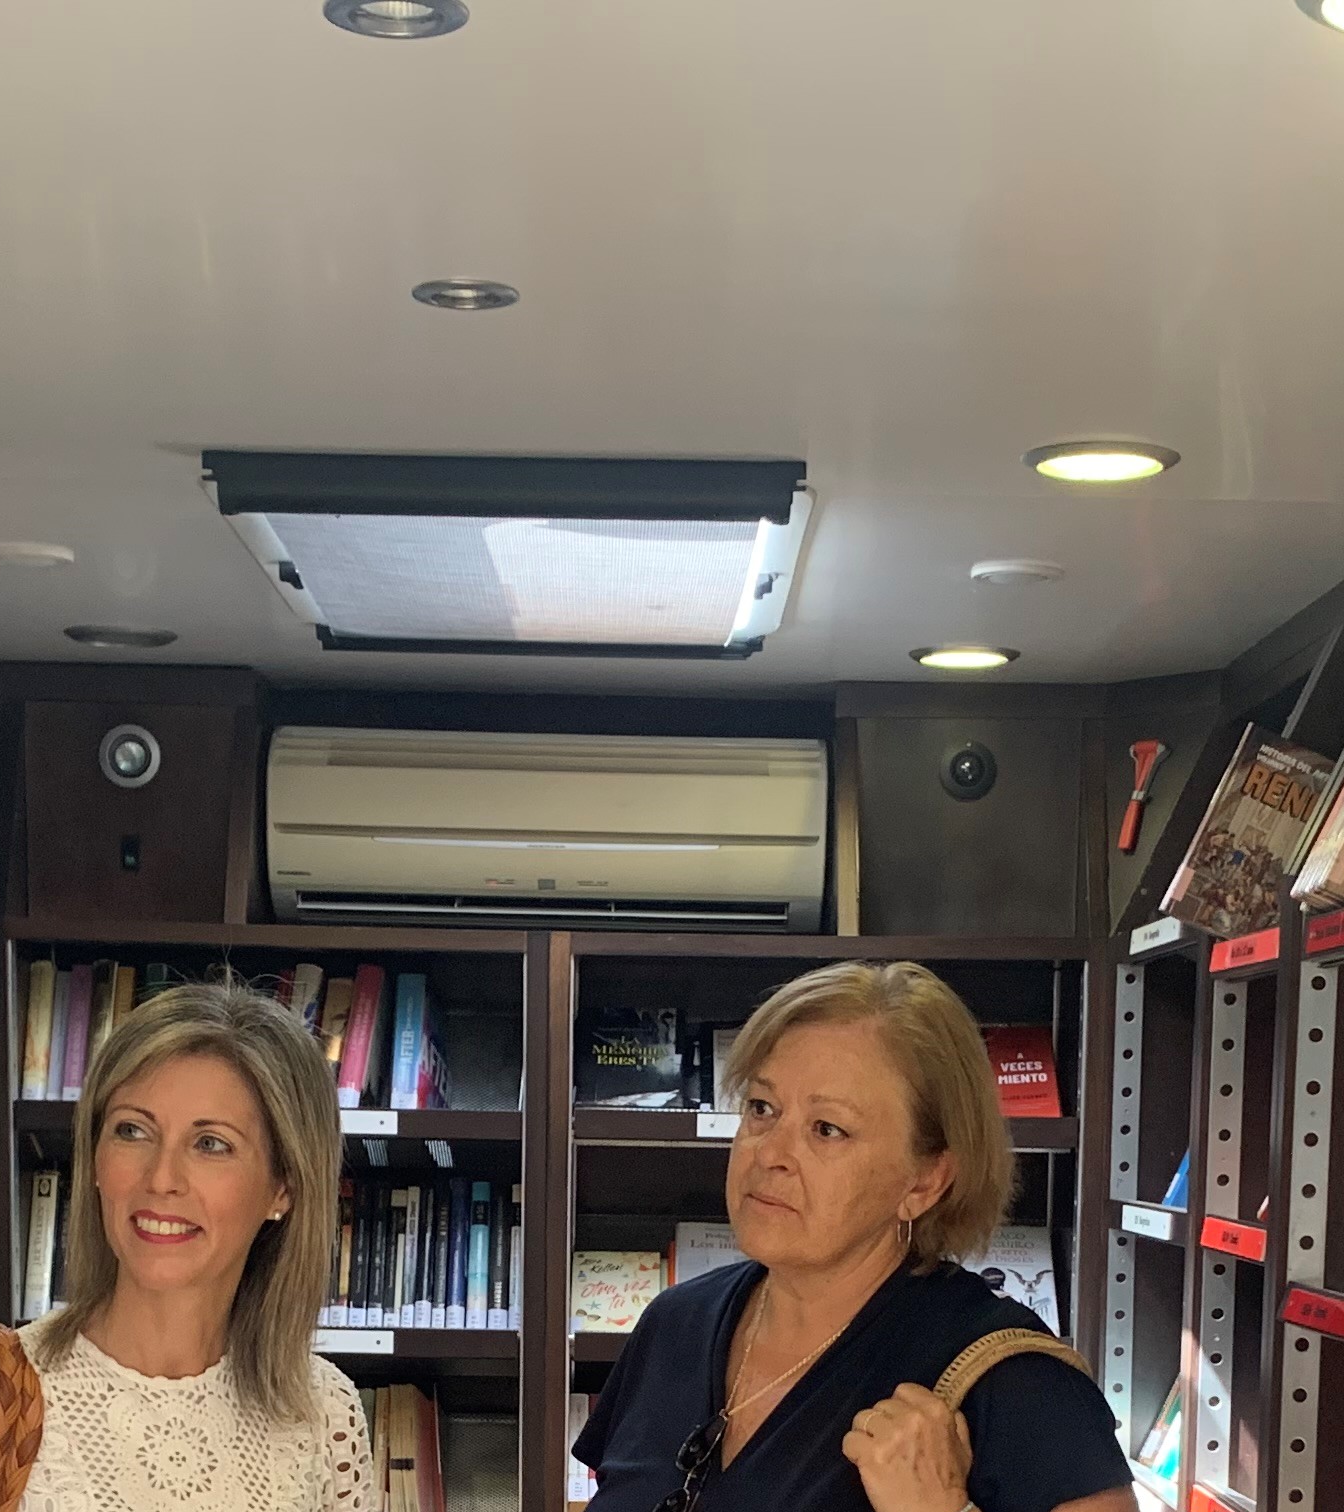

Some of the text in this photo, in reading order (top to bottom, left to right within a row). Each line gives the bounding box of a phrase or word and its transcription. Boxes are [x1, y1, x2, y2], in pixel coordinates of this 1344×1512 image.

[399, 1030, 415, 1064] AFTER
[1000, 1061, 1043, 1072] VECES
[998, 1072, 1048, 1085] MIENTO
